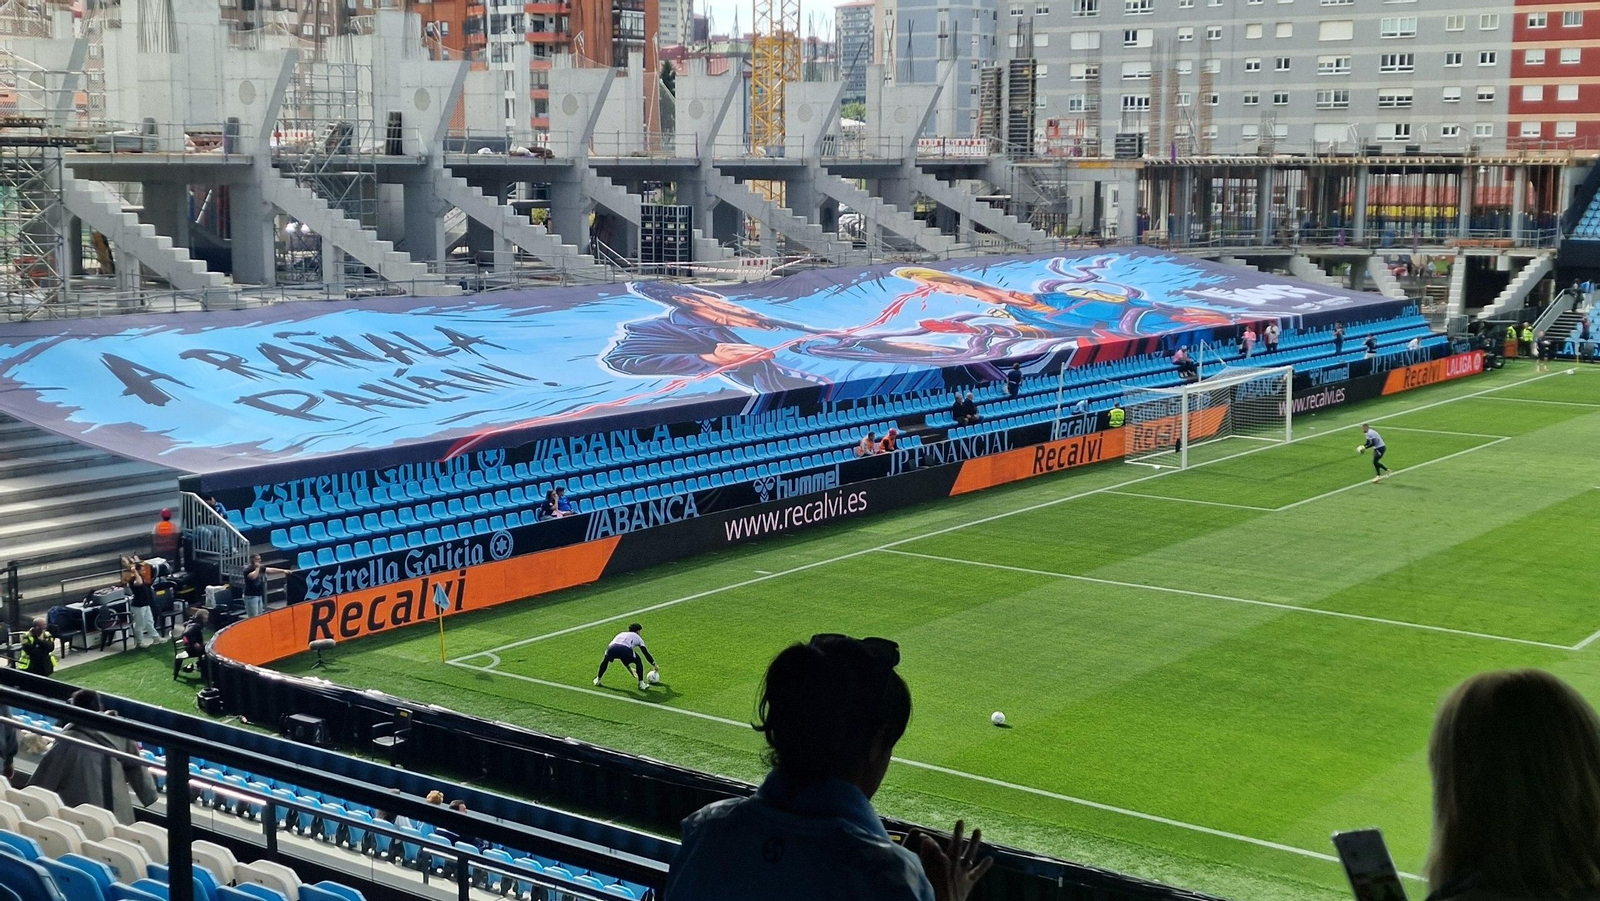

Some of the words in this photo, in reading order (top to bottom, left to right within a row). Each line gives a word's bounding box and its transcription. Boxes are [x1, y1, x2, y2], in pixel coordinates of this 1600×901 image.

[99, 352, 194, 407] A
[1320, 362, 1350, 385] hummel
[1403, 359, 1441, 388] Recalvi
[1446, 354, 1472, 377] LALIGA
[1050, 412, 1098, 441] Recalvi
[886, 449, 910, 476] JP
[1033, 433, 1103, 474] Recalvi
[777, 464, 840, 500] hummel
[724, 489, 867, 541] www.recalvi.es
[304, 558, 400, 601] Estrella
[404, 539, 485, 579] Galicia
